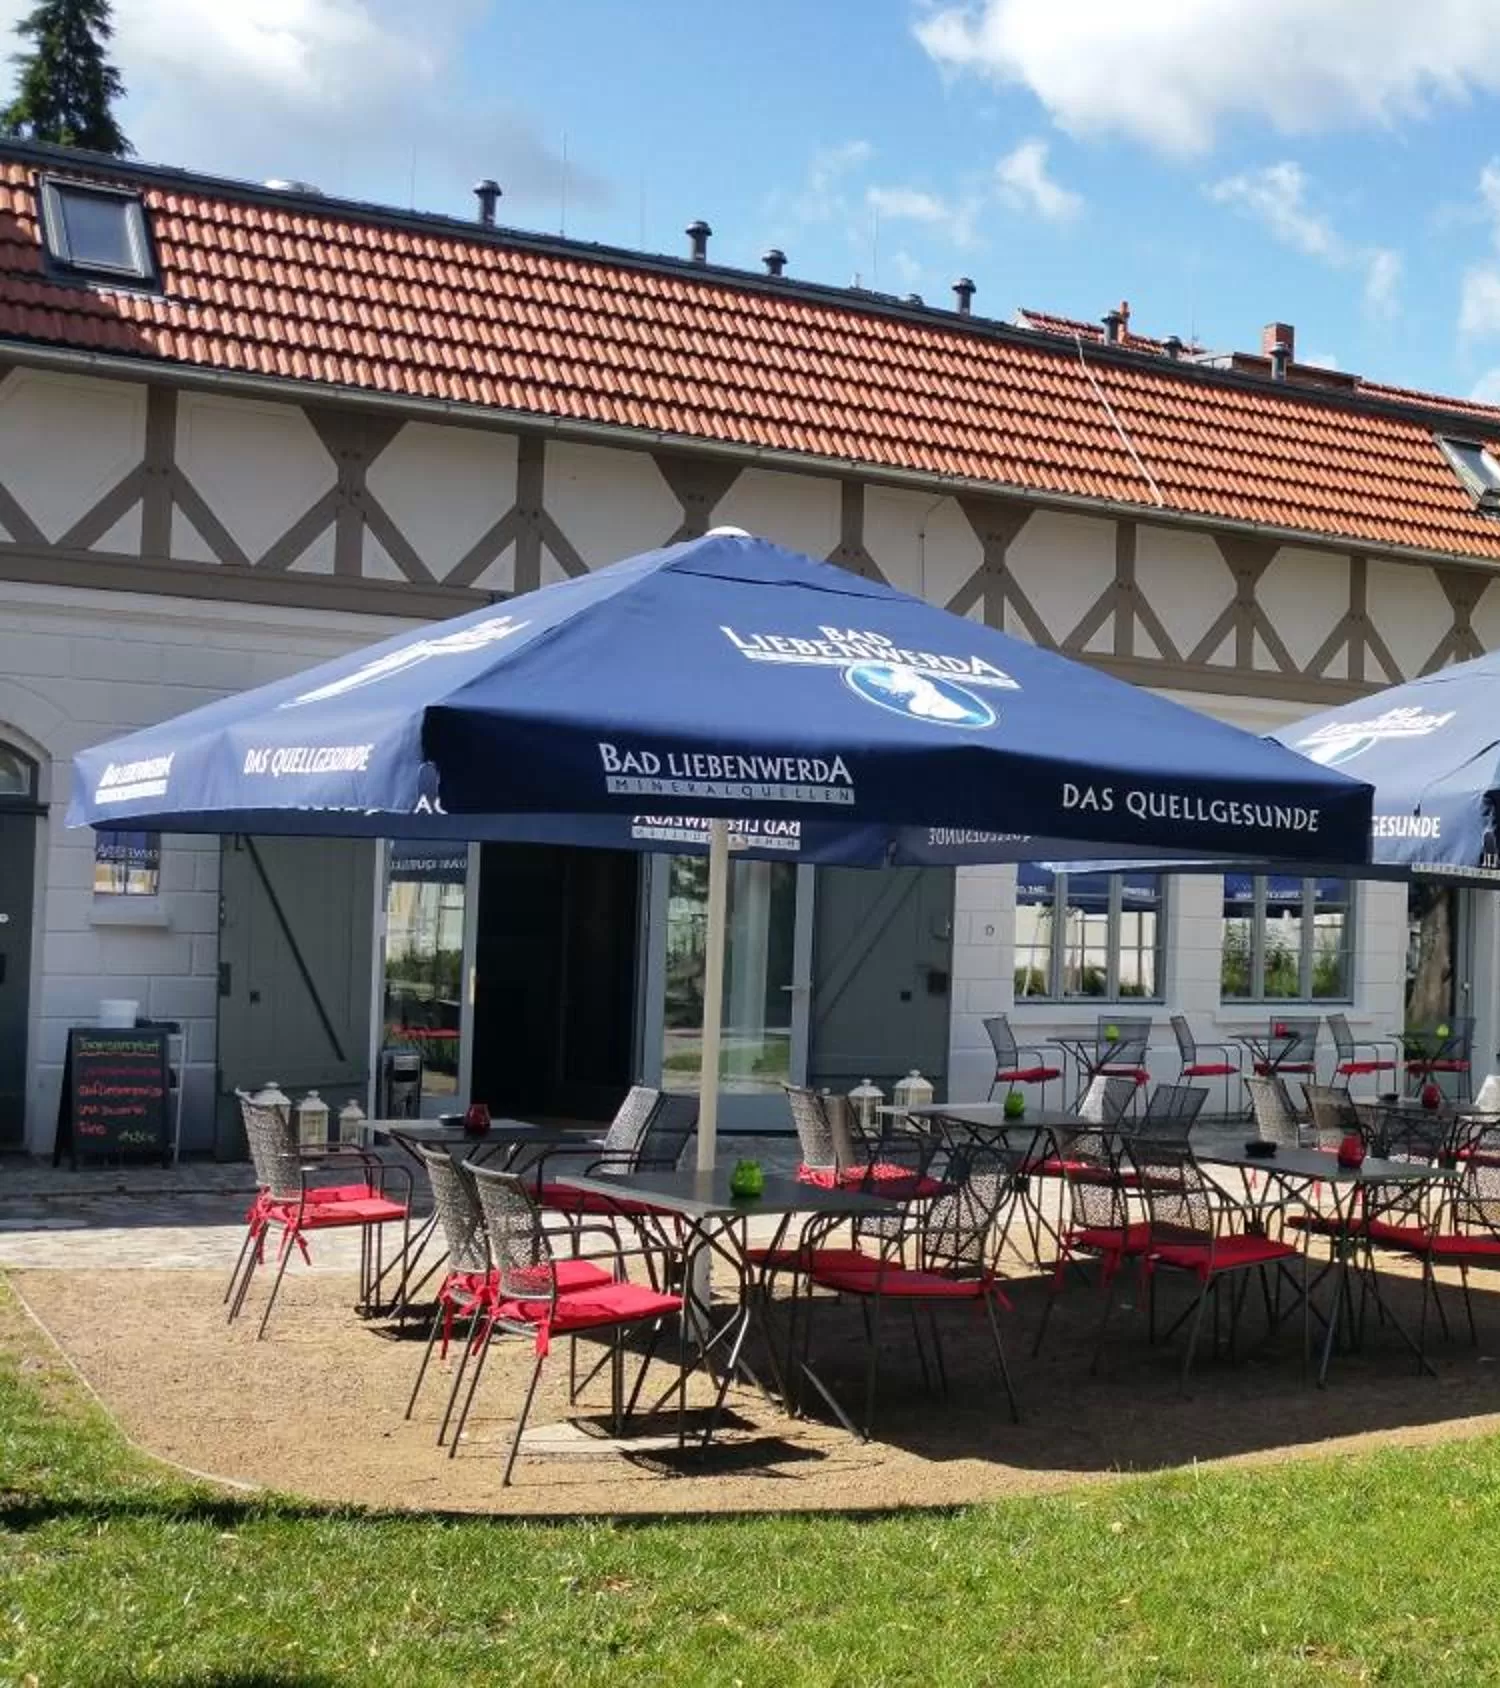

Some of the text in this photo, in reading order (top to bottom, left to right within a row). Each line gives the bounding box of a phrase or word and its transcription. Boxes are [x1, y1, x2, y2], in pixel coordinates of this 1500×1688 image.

[720, 625, 1010, 679] LIEBENWERDA
[817, 625, 892, 649] BAD
[599, 743, 854, 785] BAD LIEBENWERDA
[1062, 783, 1320, 833] DAS QUELLGESUNDE
